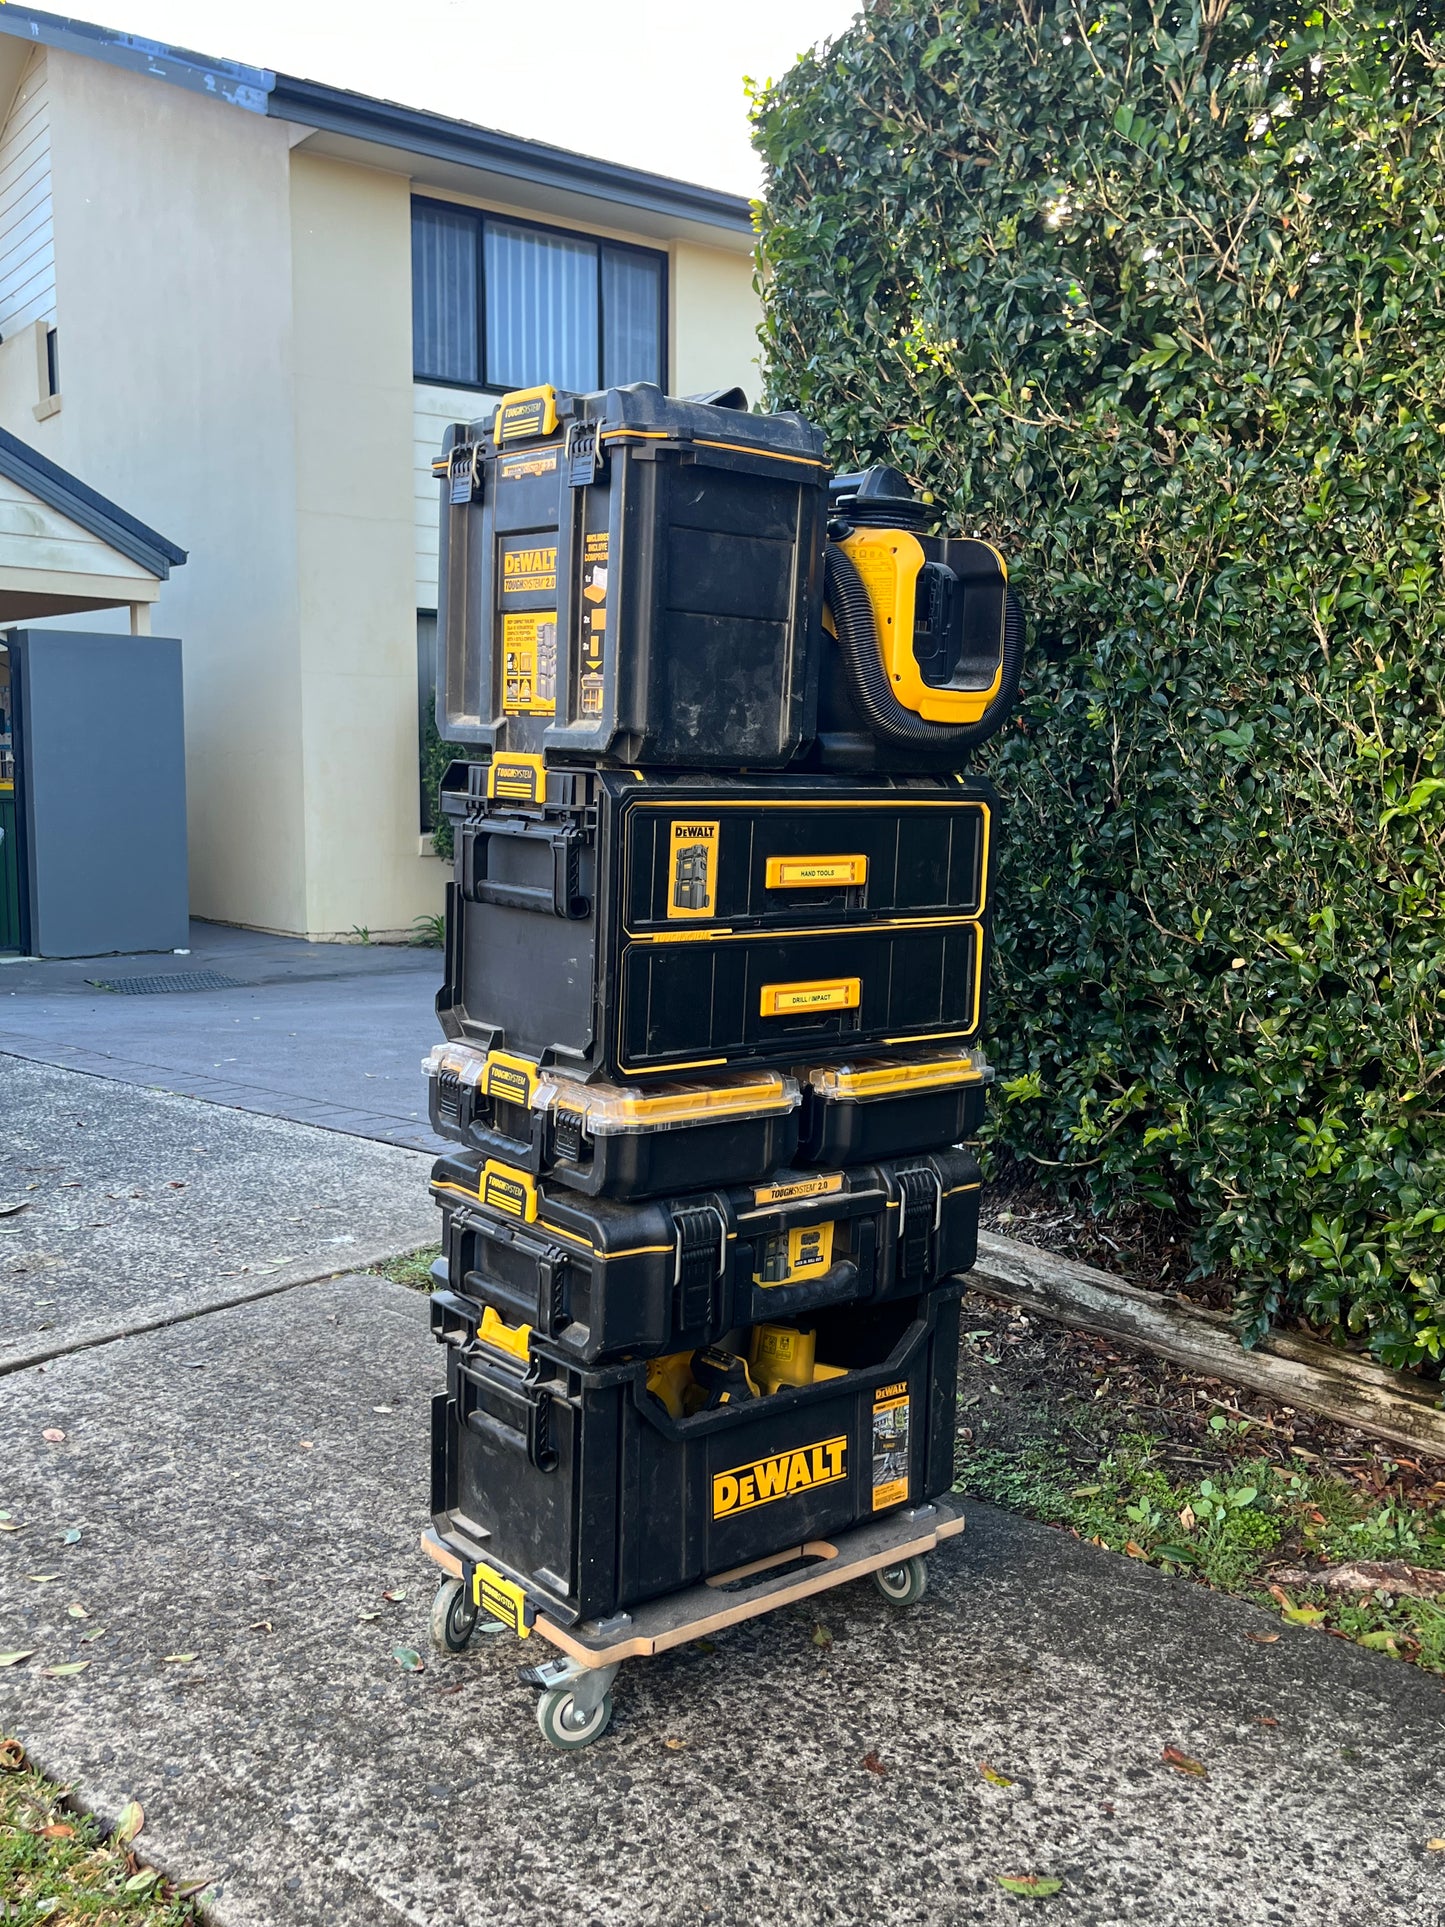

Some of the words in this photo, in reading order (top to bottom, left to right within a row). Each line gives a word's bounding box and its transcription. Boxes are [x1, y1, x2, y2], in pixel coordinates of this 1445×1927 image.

[545, 577, 555, 588] 2.0
[497, 768, 532, 779] TOUGHSYSTEM
[811, 994, 831, 1002] IMPACT
[491, 1066, 526, 1085] TOUGHSYSTEM
[489, 1175, 523, 1197] TOUGHSYSTEM
[771, 1182, 816, 1199] TOUGHSYSTEM
[817, 1181, 828, 1191] 2.0
[714, 1440, 847, 1515] DEWALT
